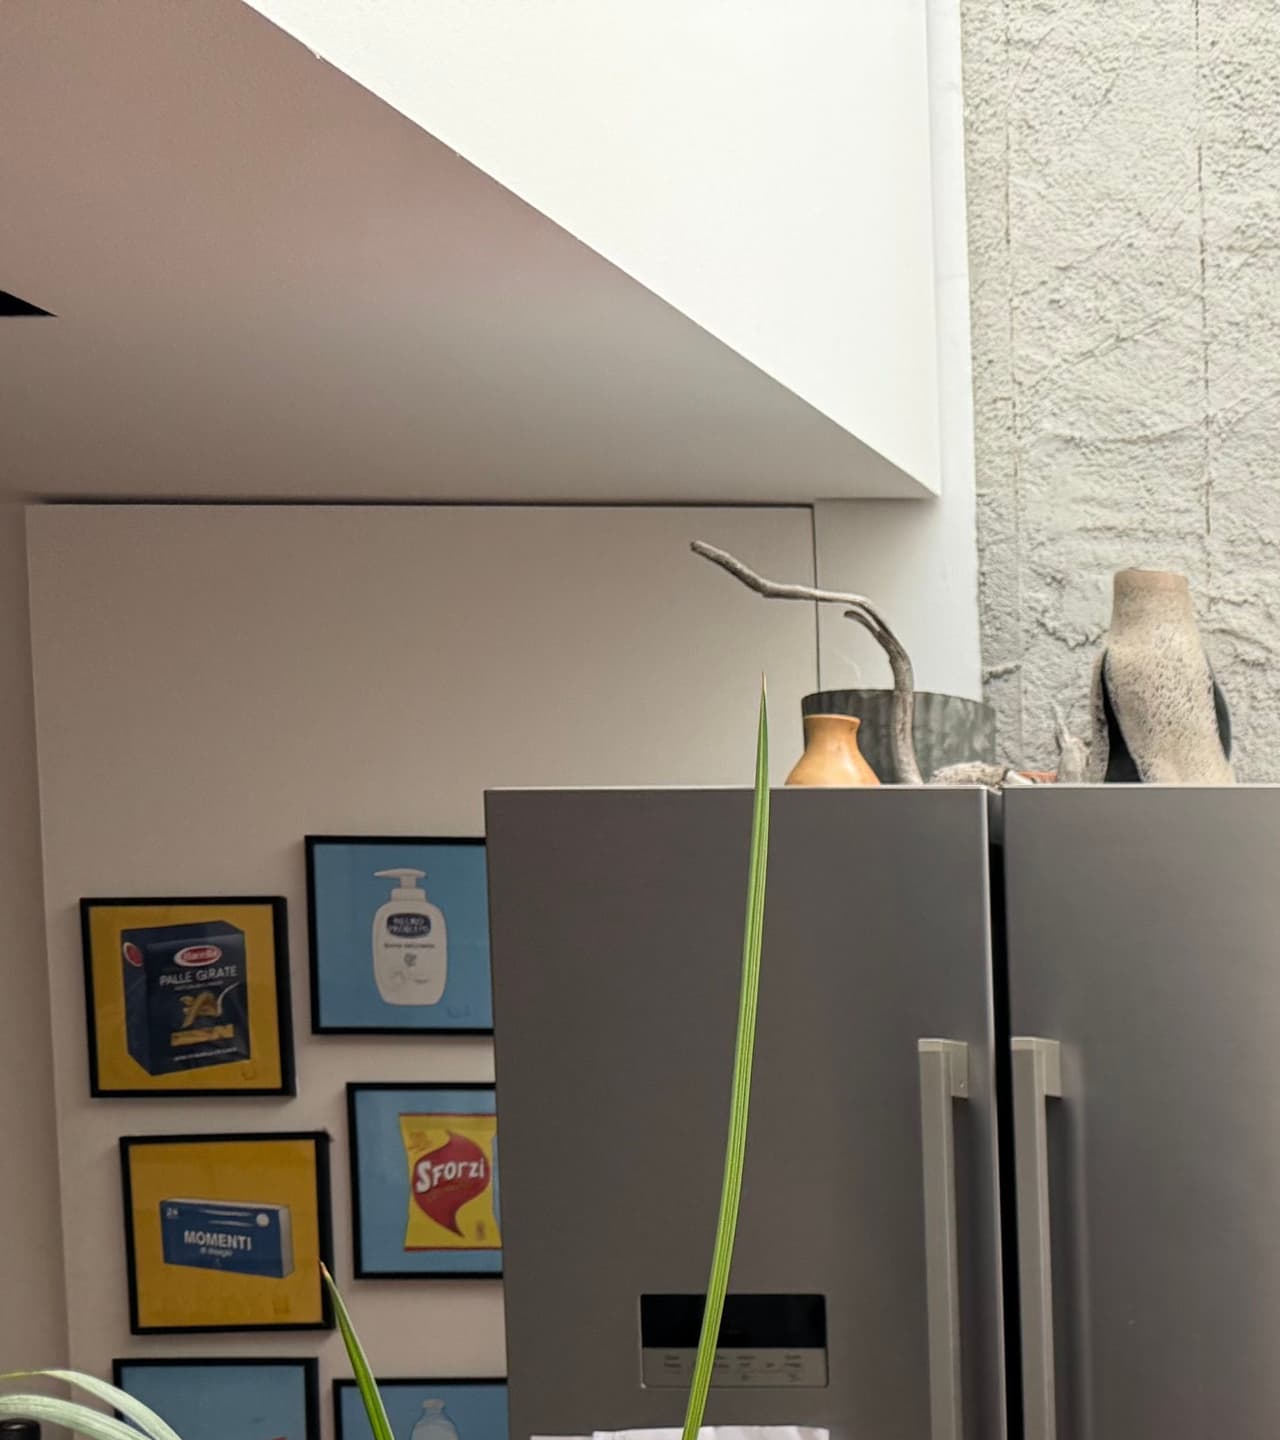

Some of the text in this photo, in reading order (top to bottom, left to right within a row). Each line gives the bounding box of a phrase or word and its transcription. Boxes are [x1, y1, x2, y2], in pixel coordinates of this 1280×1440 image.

[159, 971, 193, 986] PALLE
[195, 965, 238, 981] GIRATE
[184, 1230, 252, 1250] MOMENTI
